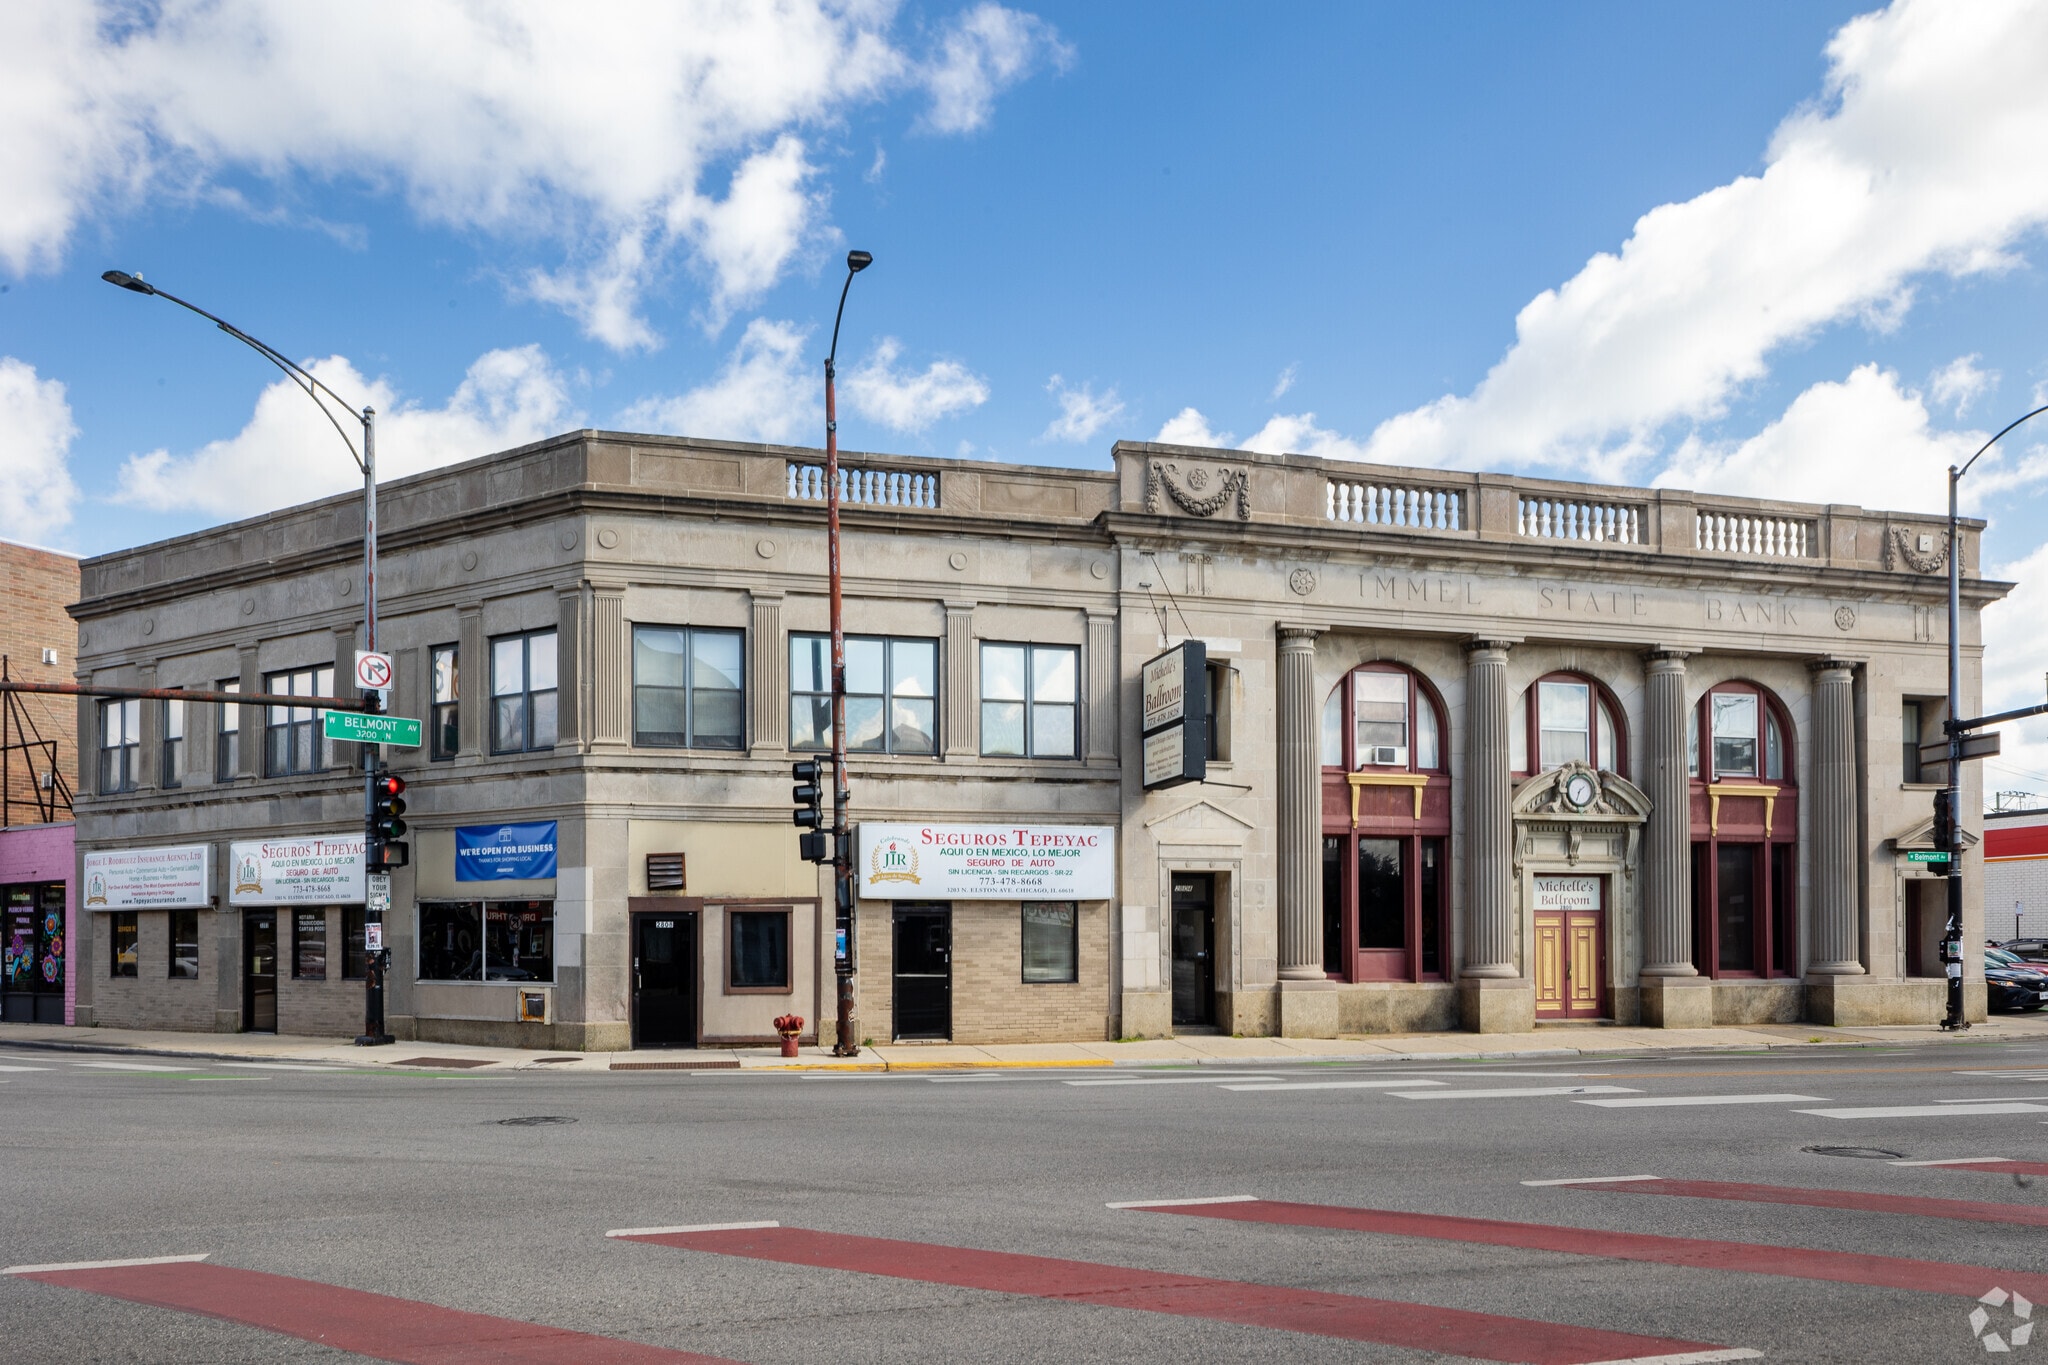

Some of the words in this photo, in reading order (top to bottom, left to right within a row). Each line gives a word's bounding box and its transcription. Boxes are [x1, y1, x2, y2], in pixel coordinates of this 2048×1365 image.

[1359, 574, 1481, 605] IMMEL
[1541, 587, 1647, 616] STATE
[1707, 600, 1797, 625] BANK
[1150, 658, 1176, 683] Michelle's
[1146, 684, 1181, 713] Ballroom
[329, 716, 336, 724] W
[345, 716, 397, 731] BELMONT
[356, 730, 377, 739] 3200
[921, 828, 1007, 845] SEGUROS
[1013, 830, 1098, 847] TEPEYAC
[262, 844, 310, 859] SEGUROS
[314, 841, 366, 856] TEPEYAC
[460, 848, 480, 856] WE'RE
[482, 847, 500, 855] OPEN
[503, 846, 516, 854] FOR
[518, 844, 553, 853] BUSINESS
[940, 848, 963, 856] AQUI
[966, 848, 973, 856] O
[976, 848, 989, 856] EN
[992, 848, 1030, 857] MEXICO,
[1033, 849, 1045, 857] LO
[1048, 849, 1080, 857] MEJOR
[86, 858, 101, 869] JORGE
[108, 856, 136, 865] RODRIGUEZ
[137, 855, 165, 864] INSURANCE
[167, 853, 189, 862] AGENCY,
[271, 860, 285, 868] AQUI
[301, 858, 323, 867] MEXICO,
[335, 857, 354, 865] MEJOR
[882, 851, 906, 868] JIR
[185, 864, 200, 872] Liability
[242, 865, 255, 880] JIR
[312, 868, 320, 876] DE
[980, 877, 1043, 885] 773-478-8668
[1538, 880, 1594, 892] Michelle's
[293, 884, 331, 893] 773-478-8668
[1541, 894, 1590, 905] Ballroom
